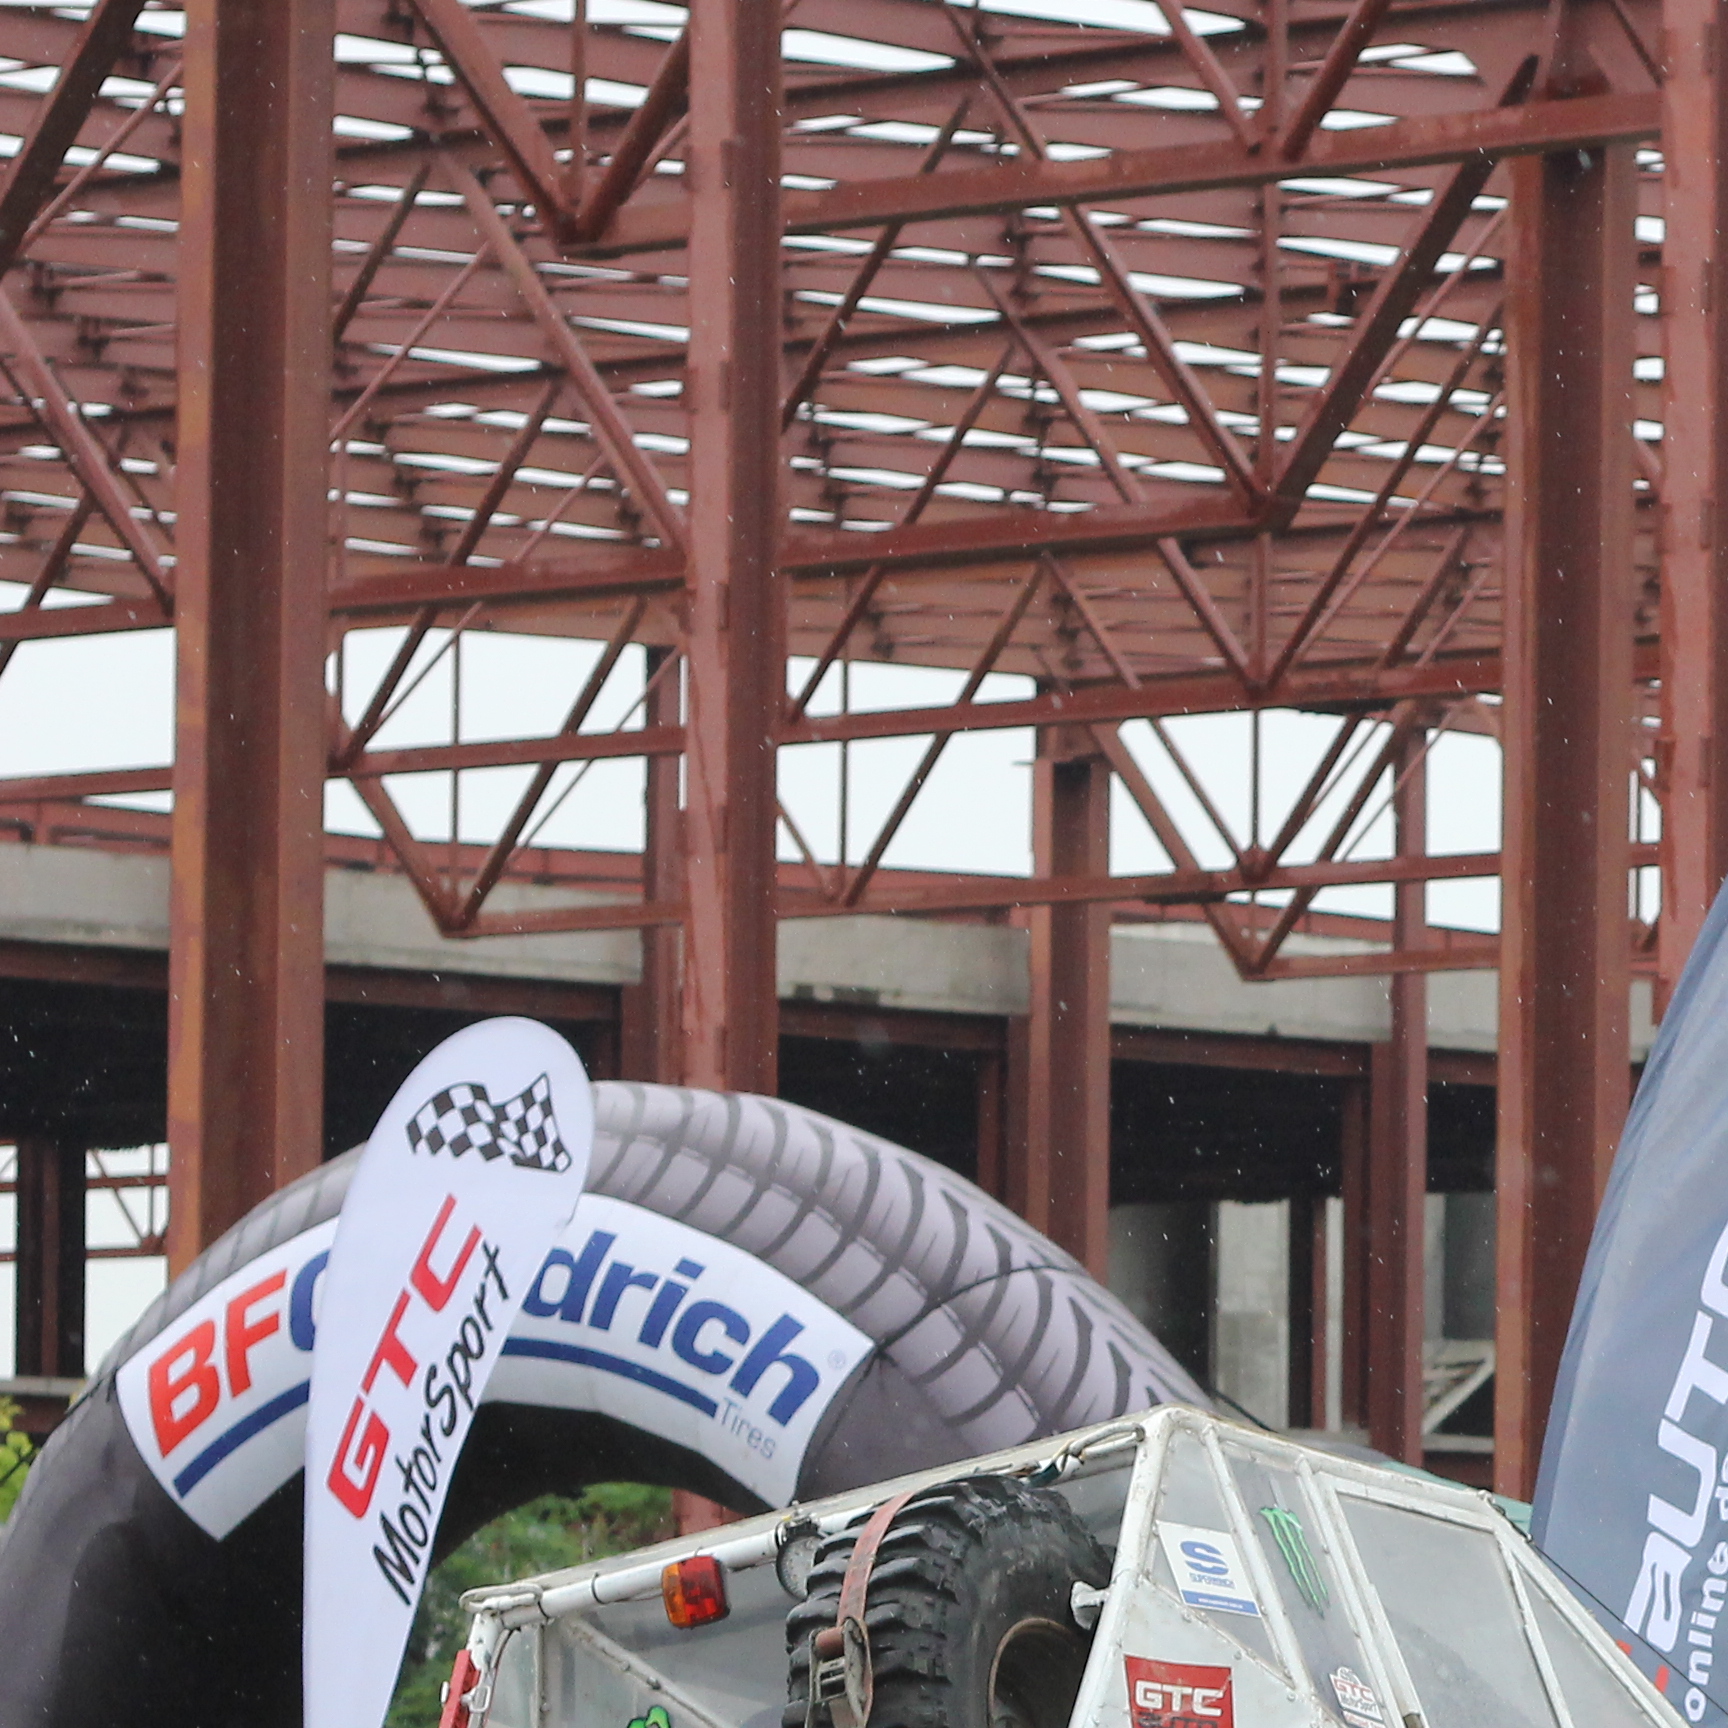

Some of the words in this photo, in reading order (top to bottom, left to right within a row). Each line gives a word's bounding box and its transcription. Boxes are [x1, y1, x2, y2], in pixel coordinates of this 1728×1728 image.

[147, 1230, 821, 1459] BFdrich
[327, 1193, 482, 1520] GTC
[372, 1242, 510, 1608] MotorSport
[716, 1400, 777, 1461] Tires
[1135, 1679, 1224, 1716] GTC
[1333, 1678, 1373, 1702] GTC
